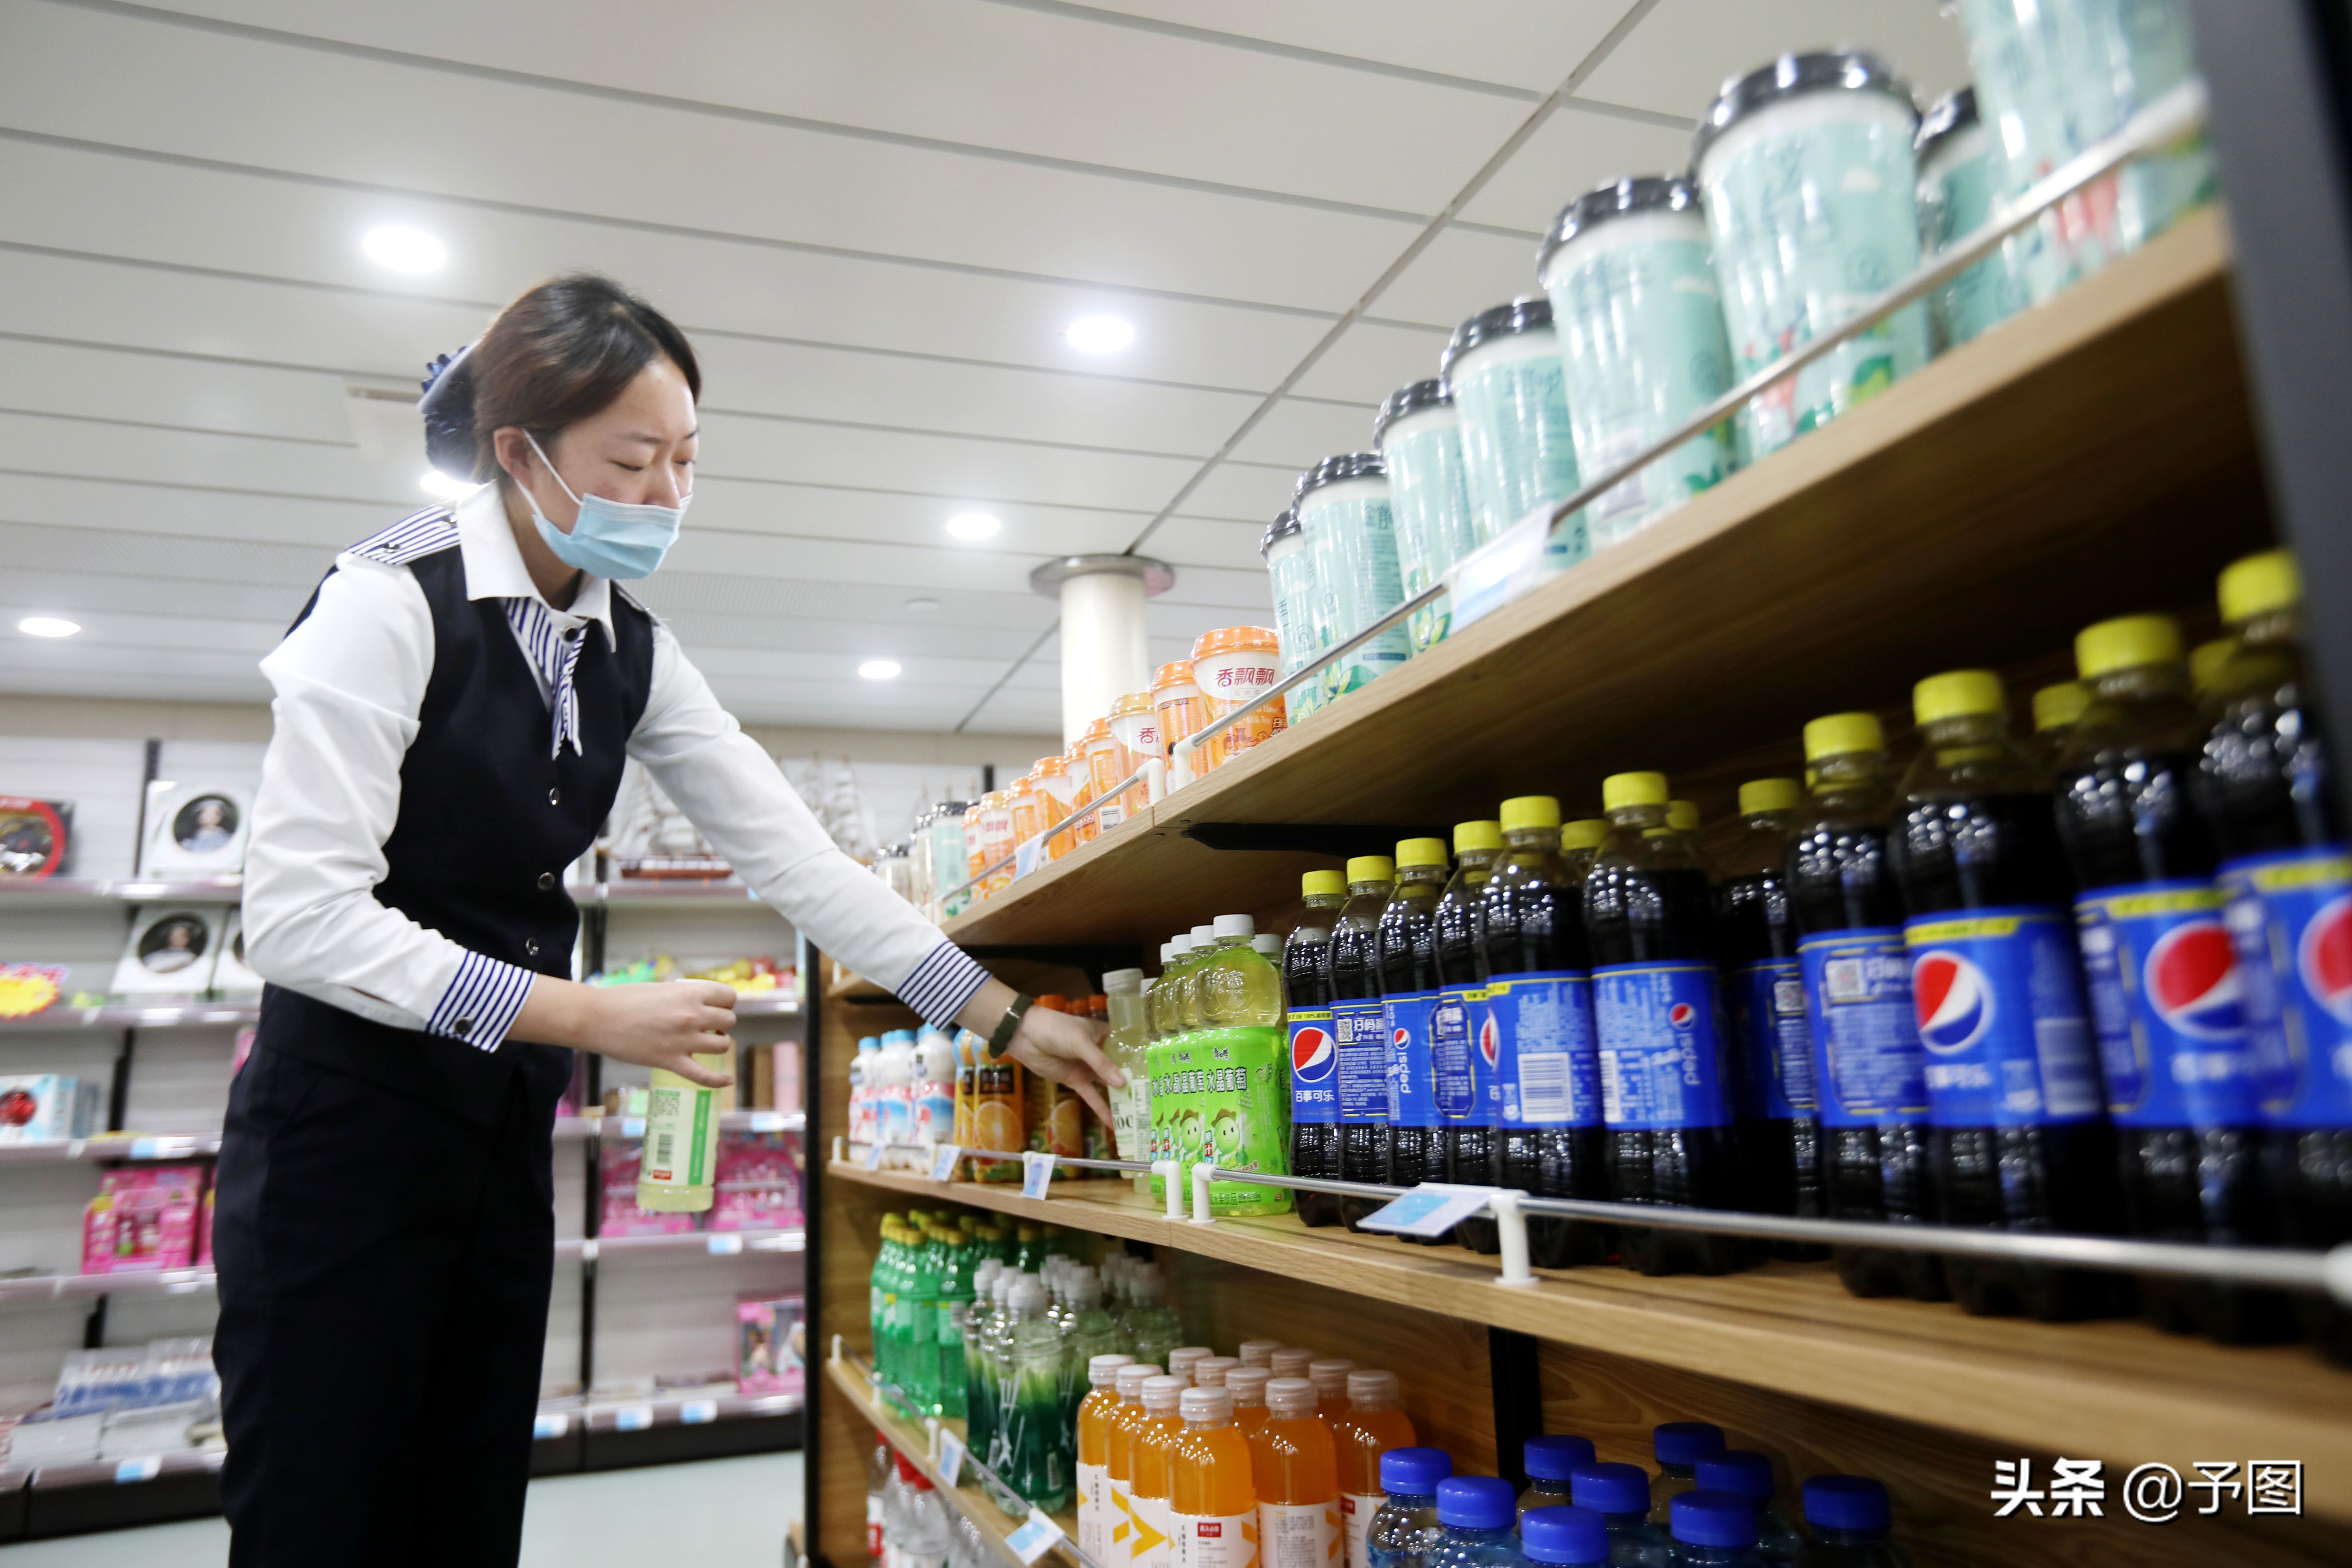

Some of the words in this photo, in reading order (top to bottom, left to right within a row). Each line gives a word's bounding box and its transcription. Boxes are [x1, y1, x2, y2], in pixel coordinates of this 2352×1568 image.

[1215, 668, 1275, 687] 香飘飘
[1207, 1067, 1247, 1093] 水晶葡萄
[1397, 1052, 1412, 1094] pepsi
[1295, 1090, 1335, 1102] 百事可乐
